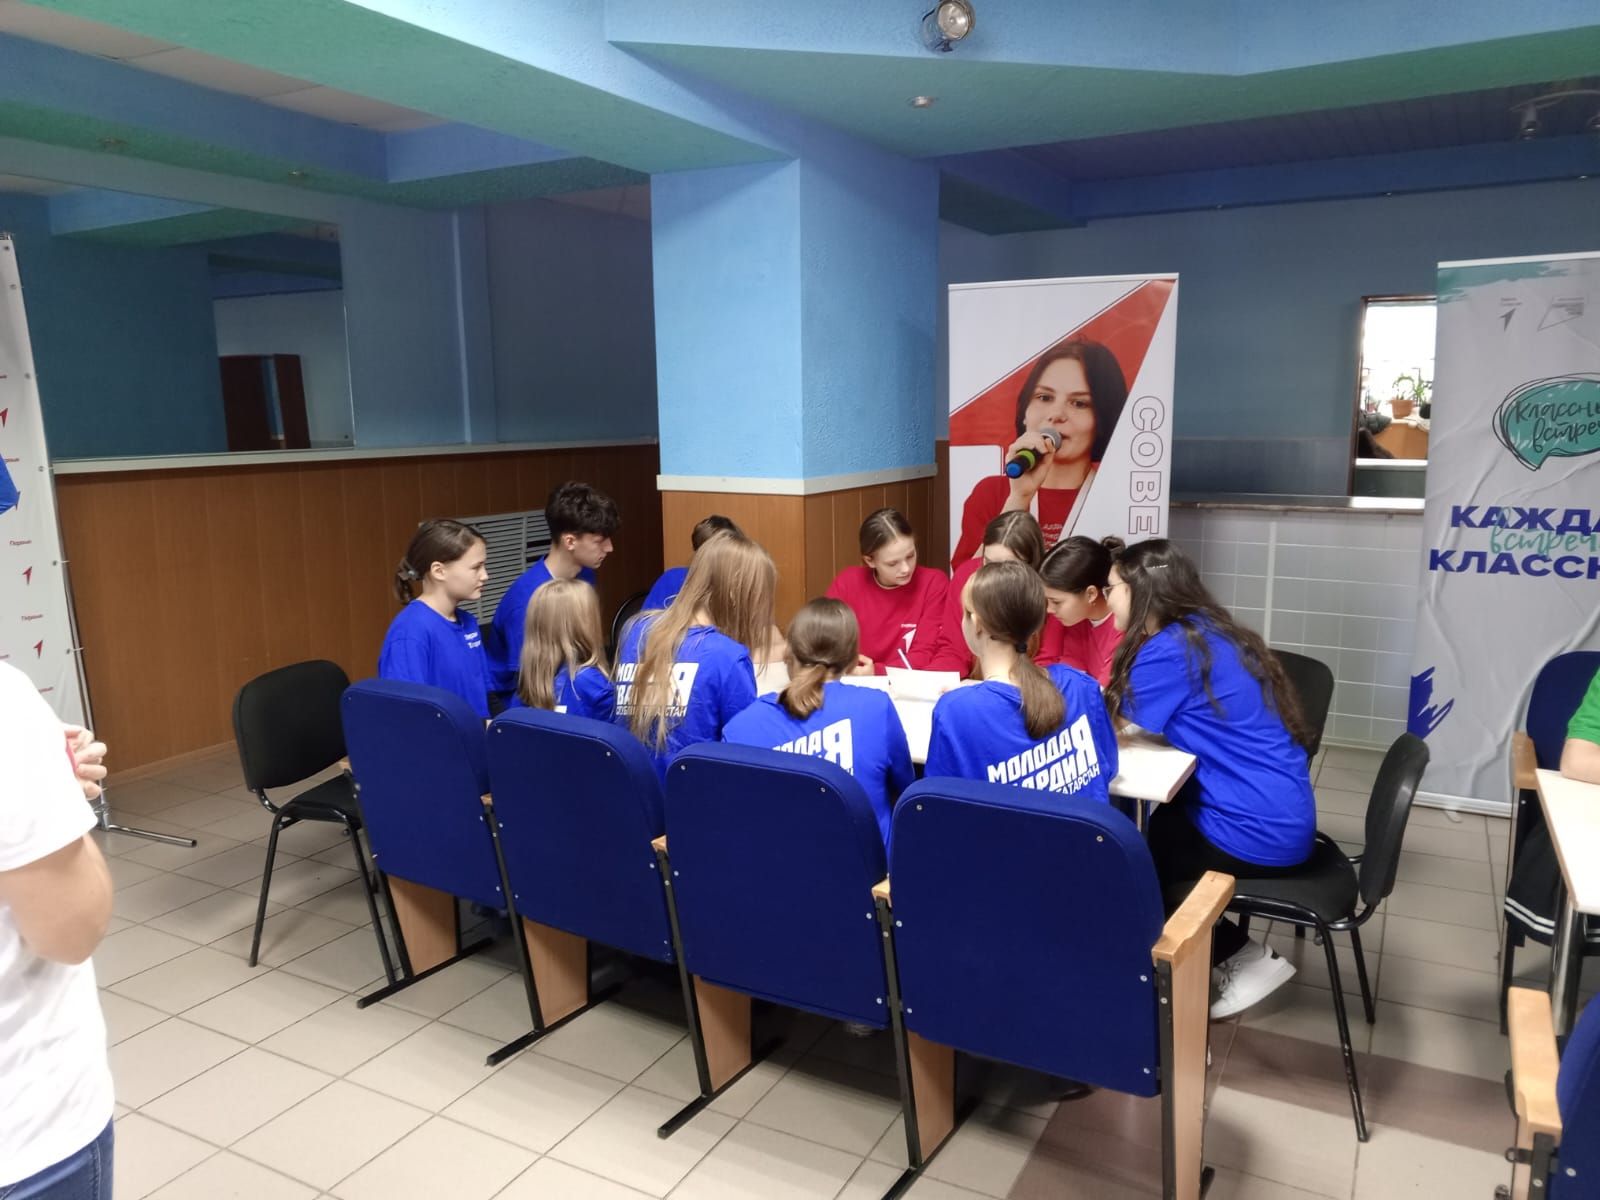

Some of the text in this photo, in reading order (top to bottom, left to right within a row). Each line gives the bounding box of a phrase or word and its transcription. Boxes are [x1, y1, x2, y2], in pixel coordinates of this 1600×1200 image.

[1128, 396, 1165, 535] СОВЕ
[1451, 505, 1600, 536] КАЖД
[1490, 507, 1600, 558] встреч
[987, 714, 1098, 784] МОЛОДАЯ
